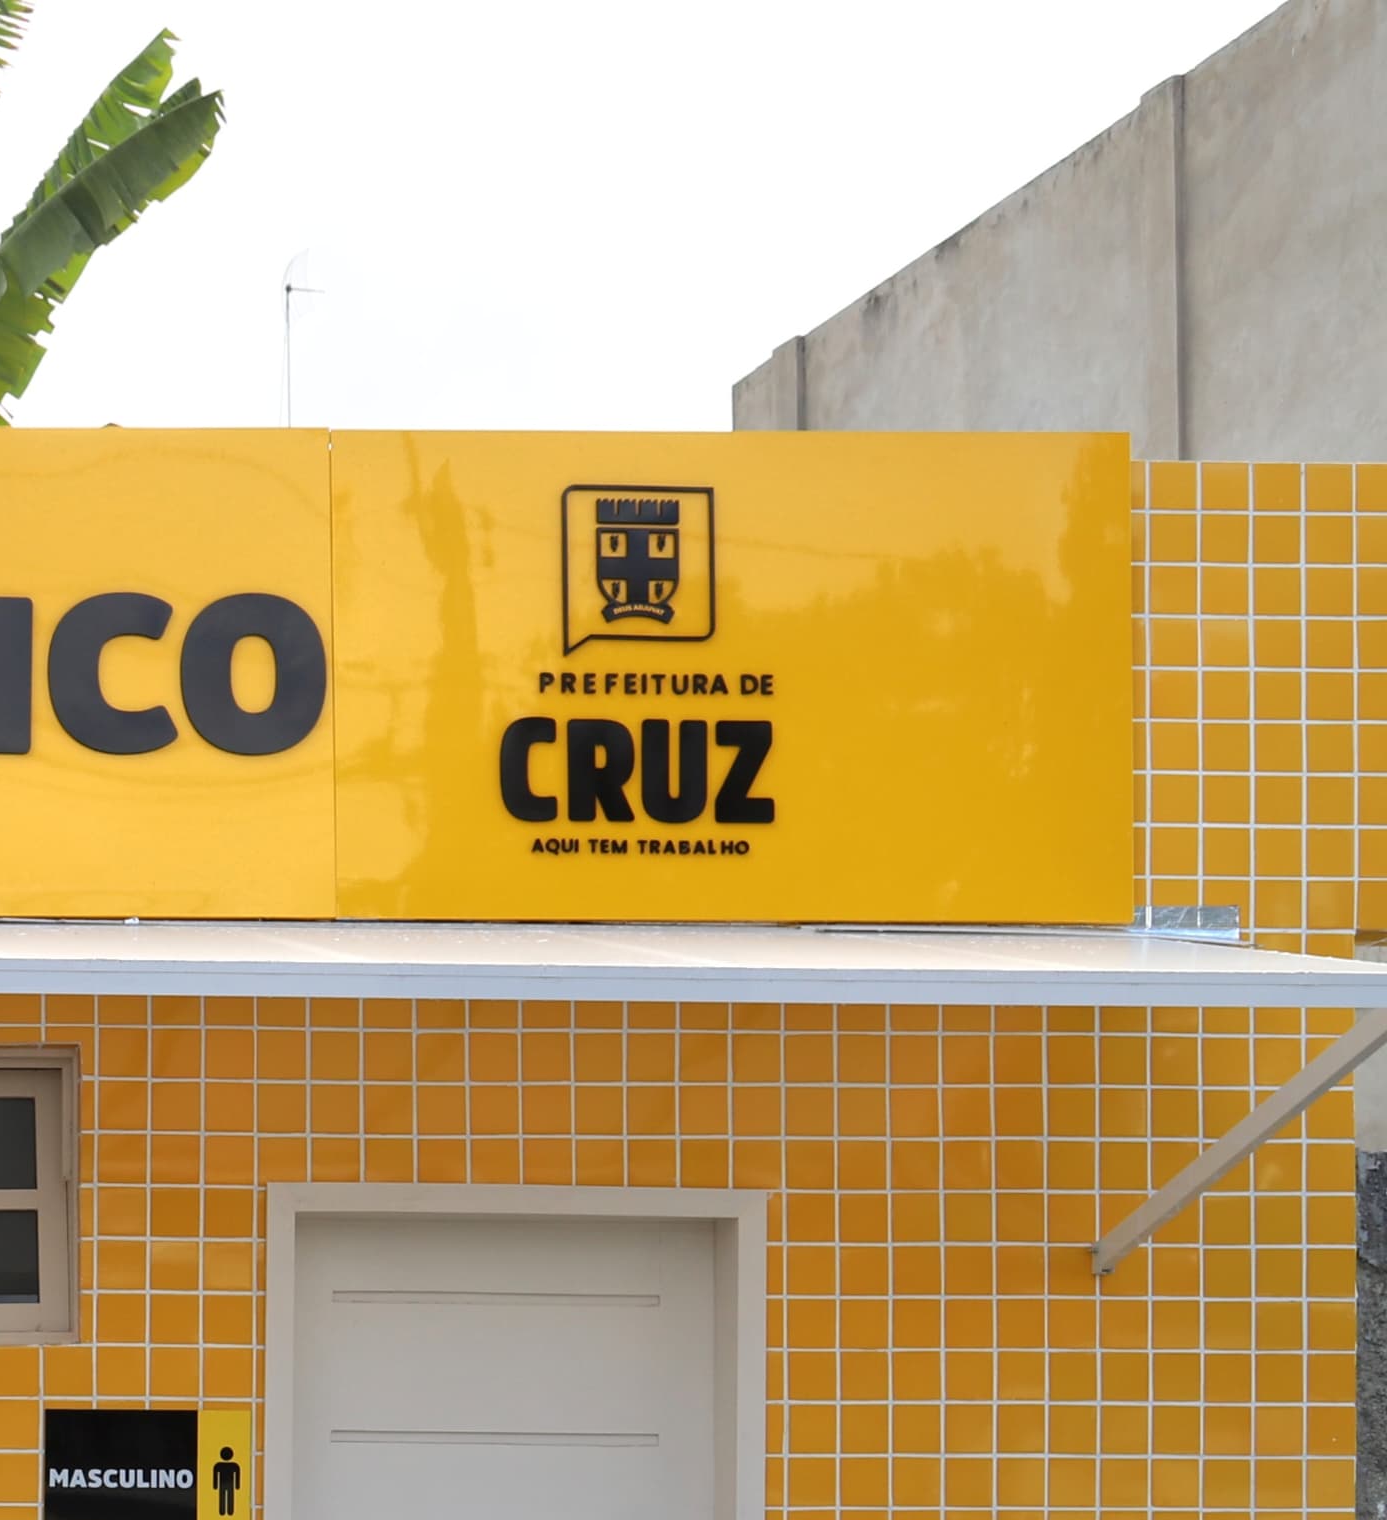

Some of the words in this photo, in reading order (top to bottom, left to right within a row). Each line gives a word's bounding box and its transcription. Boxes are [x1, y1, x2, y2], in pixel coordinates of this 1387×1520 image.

[538, 671, 729, 697] PREFEITURA
[739, 673, 774, 697] DE
[499, 716, 776, 825] CRUZ
[531, 837, 580, 857] AQUI
[587, 838, 629, 856] TEM
[636, 838, 751, 857] TRABALHO
[48, 1467, 195, 1490] MASCULINO
